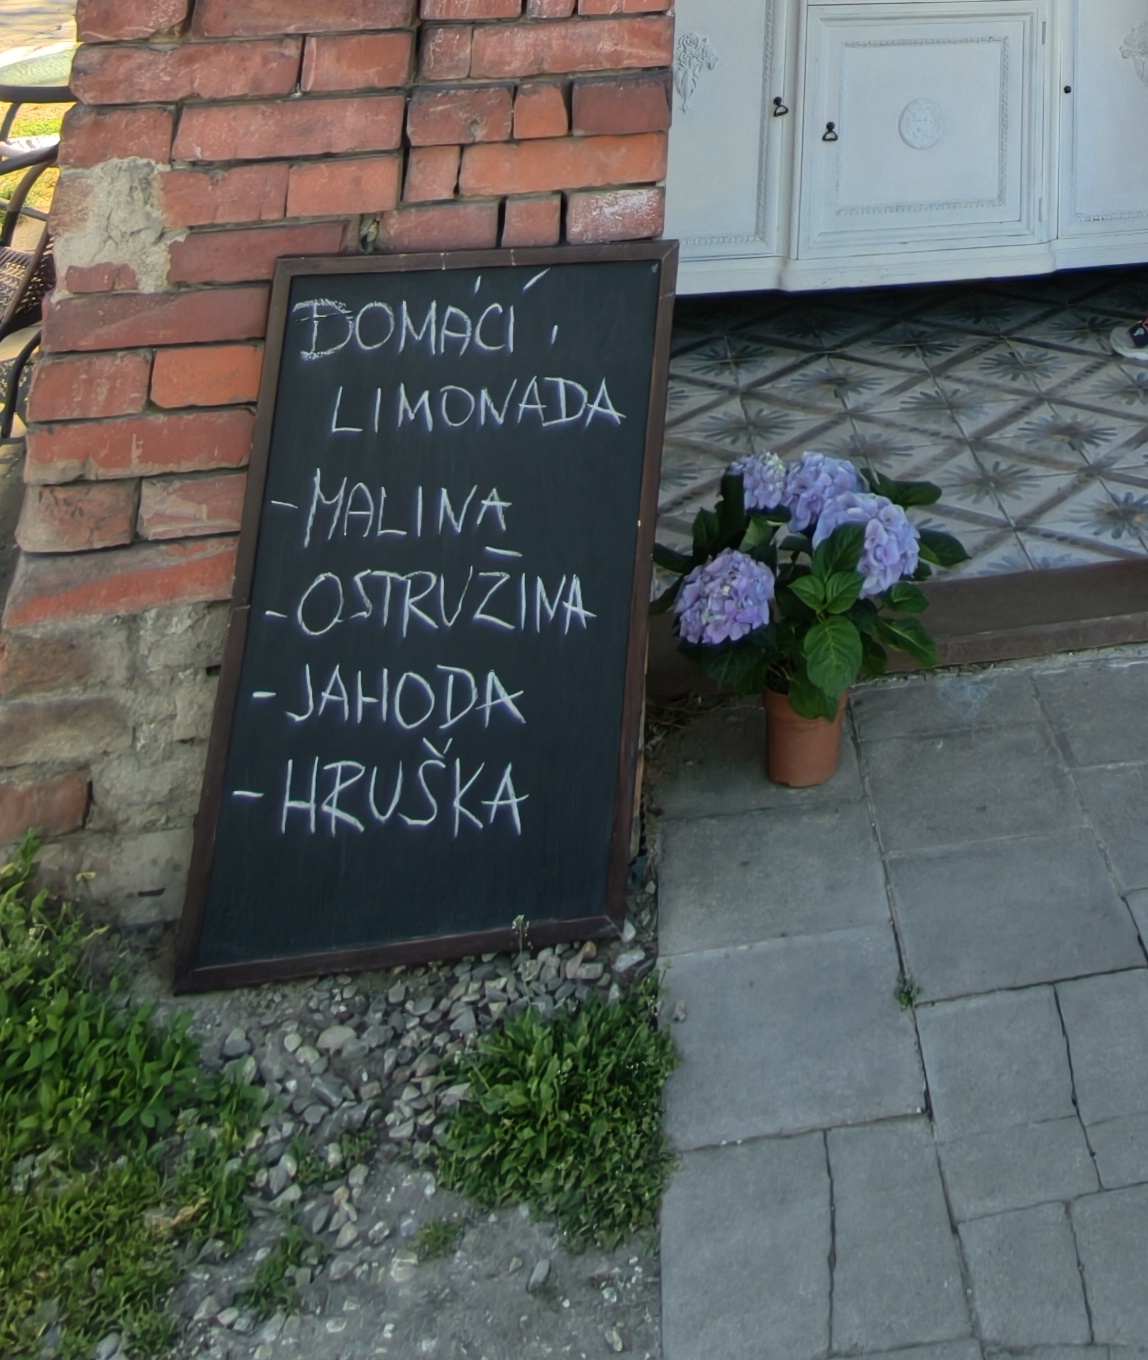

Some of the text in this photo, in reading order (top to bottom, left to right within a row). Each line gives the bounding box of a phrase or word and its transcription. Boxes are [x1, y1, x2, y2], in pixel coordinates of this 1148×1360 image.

[333, 376, 627, 433] LIMONADA
[286, 663, 527, 730] JAHODA
[280, 736, 531, 838] HRUŠKA
